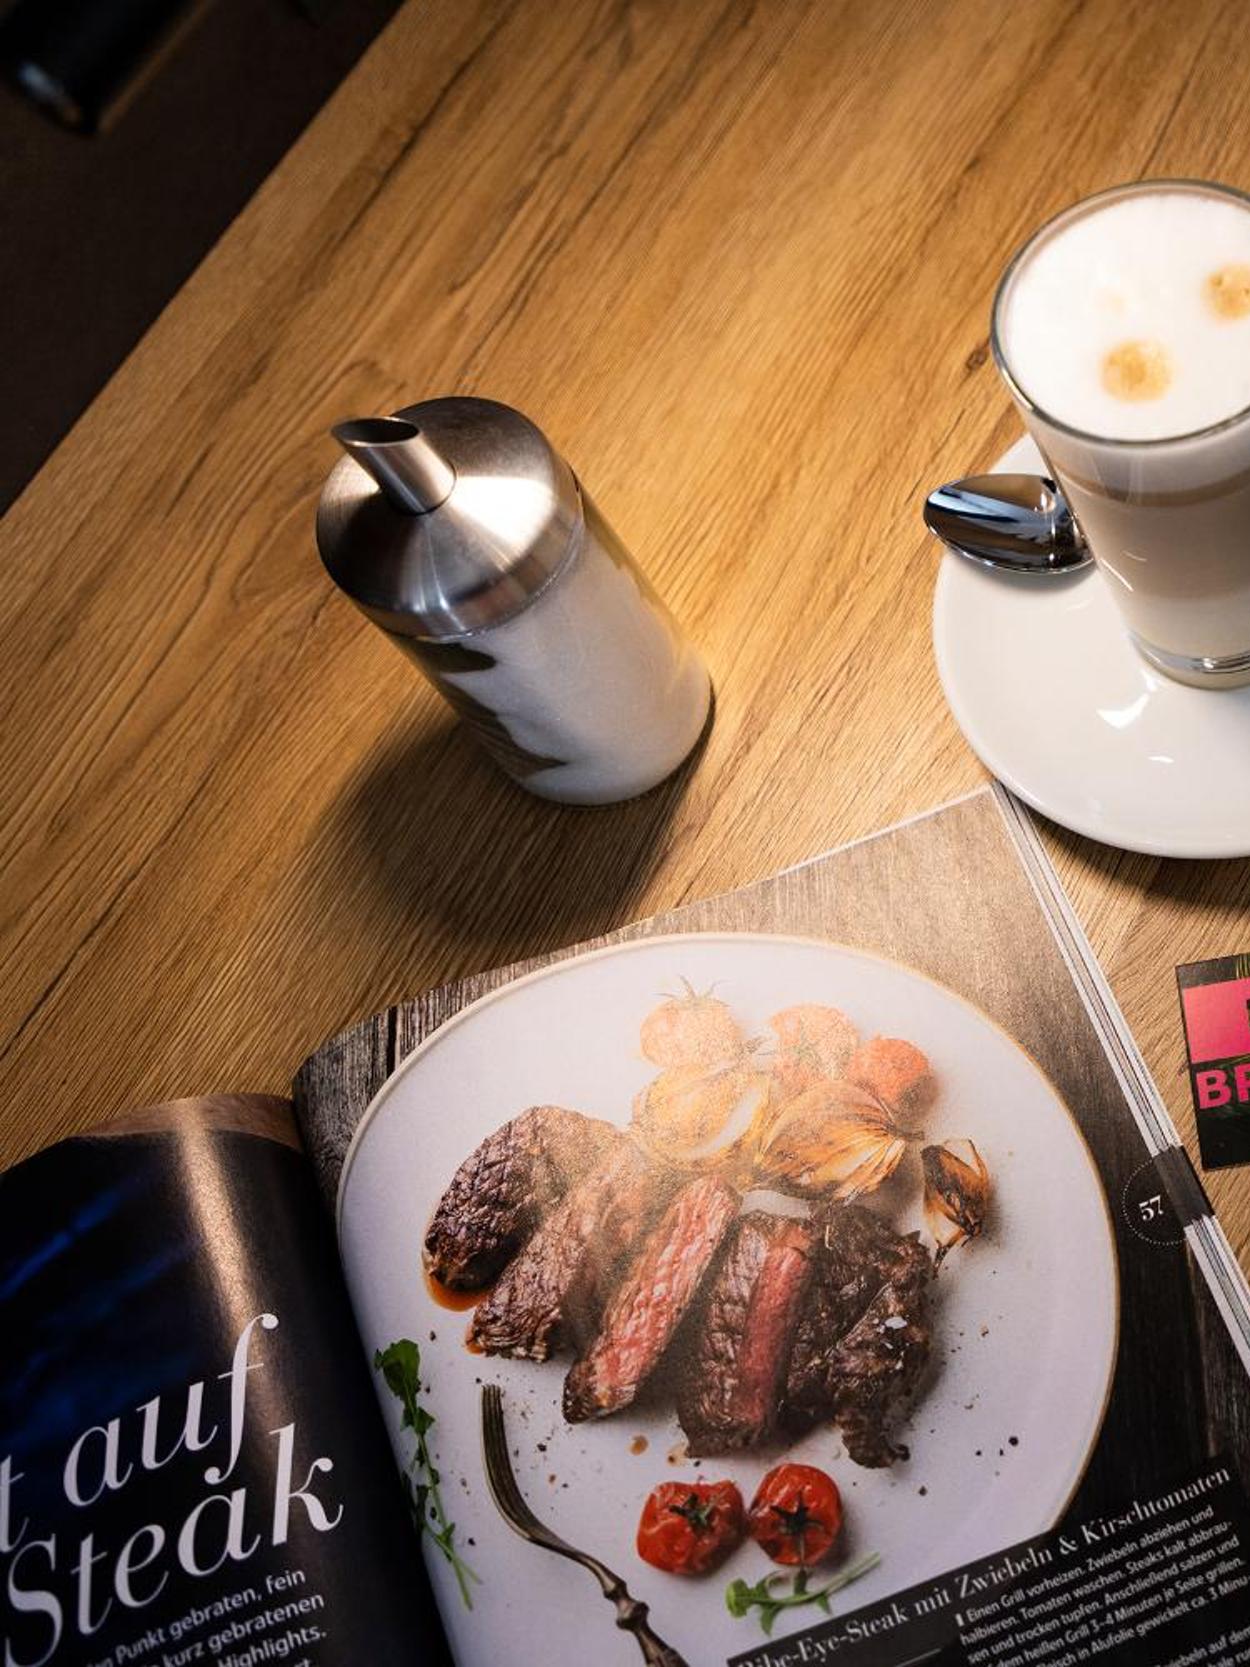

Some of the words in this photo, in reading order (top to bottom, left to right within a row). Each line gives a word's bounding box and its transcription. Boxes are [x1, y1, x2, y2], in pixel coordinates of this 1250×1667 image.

[1138, 1194, 1164, 1220] 57
[63, 1312, 279, 1507] auf
[4, 1422, 344, 1667] Steak
[737, 1602, 909, 1667] be-Eye-Steak
[914, 1587, 951, 1616] mit
[954, 1542, 1053, 1599] Zwiebeln
[1058, 1534, 1079, 1555] &
[1080, 1466, 1230, 1544] Kirschtomaten
[960, 1616, 1021, 1646] halbieren.
[1020, 1592, 1072, 1620] Tomaten
[1073, 1570, 1126, 1599] waschen.
[1125, 1550, 1164, 1575] Steaks
[1163, 1540, 1187, 1557] kalt
[1188, 1521, 1232, 1548] abbrau-
[965, 1602, 1001, 1622] Einen
[1001, 1588, 1026, 1608] Grill
[1026, 1566, 1086, 1598] vorheizen.
[1086, 1541, 1139, 1572] Zwiebeln
[1139, 1519, 1190, 1549] abziehen
[1191, 1504, 1214, 1525] und
[115, 1627, 166, 1665] Punkt
[168, 1587, 262, 1641] gebraten,
[265, 1569, 306, 1595] fein
[162, 1641, 206, 1667] kurz
[208, 1594, 325, 1654] gebratenen
[217, 1625, 327, 1667] Highlights.
[967, 1648, 990, 1664] sen
[990, 1633, 1015, 1655] und
[1015, 1617, 1060, 1644] trocken
[1060, 1601, 1103, 1626] tupfen.
[1104, 1562, 1179, 1606] Anschließend
[1179, 1548, 1216, 1572] salzen
[1216, 1534, 1240, 1555] und
[1023, 1637, 1065, 1661] heißen
[1065, 1623, 1090, 1644] Grill
[1114, 1593, 1163, 1622] Minuten
[1162, 1586, 1176, 1603] je
[1175, 1574, 1204, 1595] Seite
[1077, 1647, 1091, 1660] in
[1091, 1627, 1135, 1655] Alufolie
[1136, 1600, 1191, 1638] gewickelt
[1191, 1595, 1209, 1609] ca.
[1208, 1586, 1219, 1601] 3
[1207, 1634, 1228, 1654] auf
